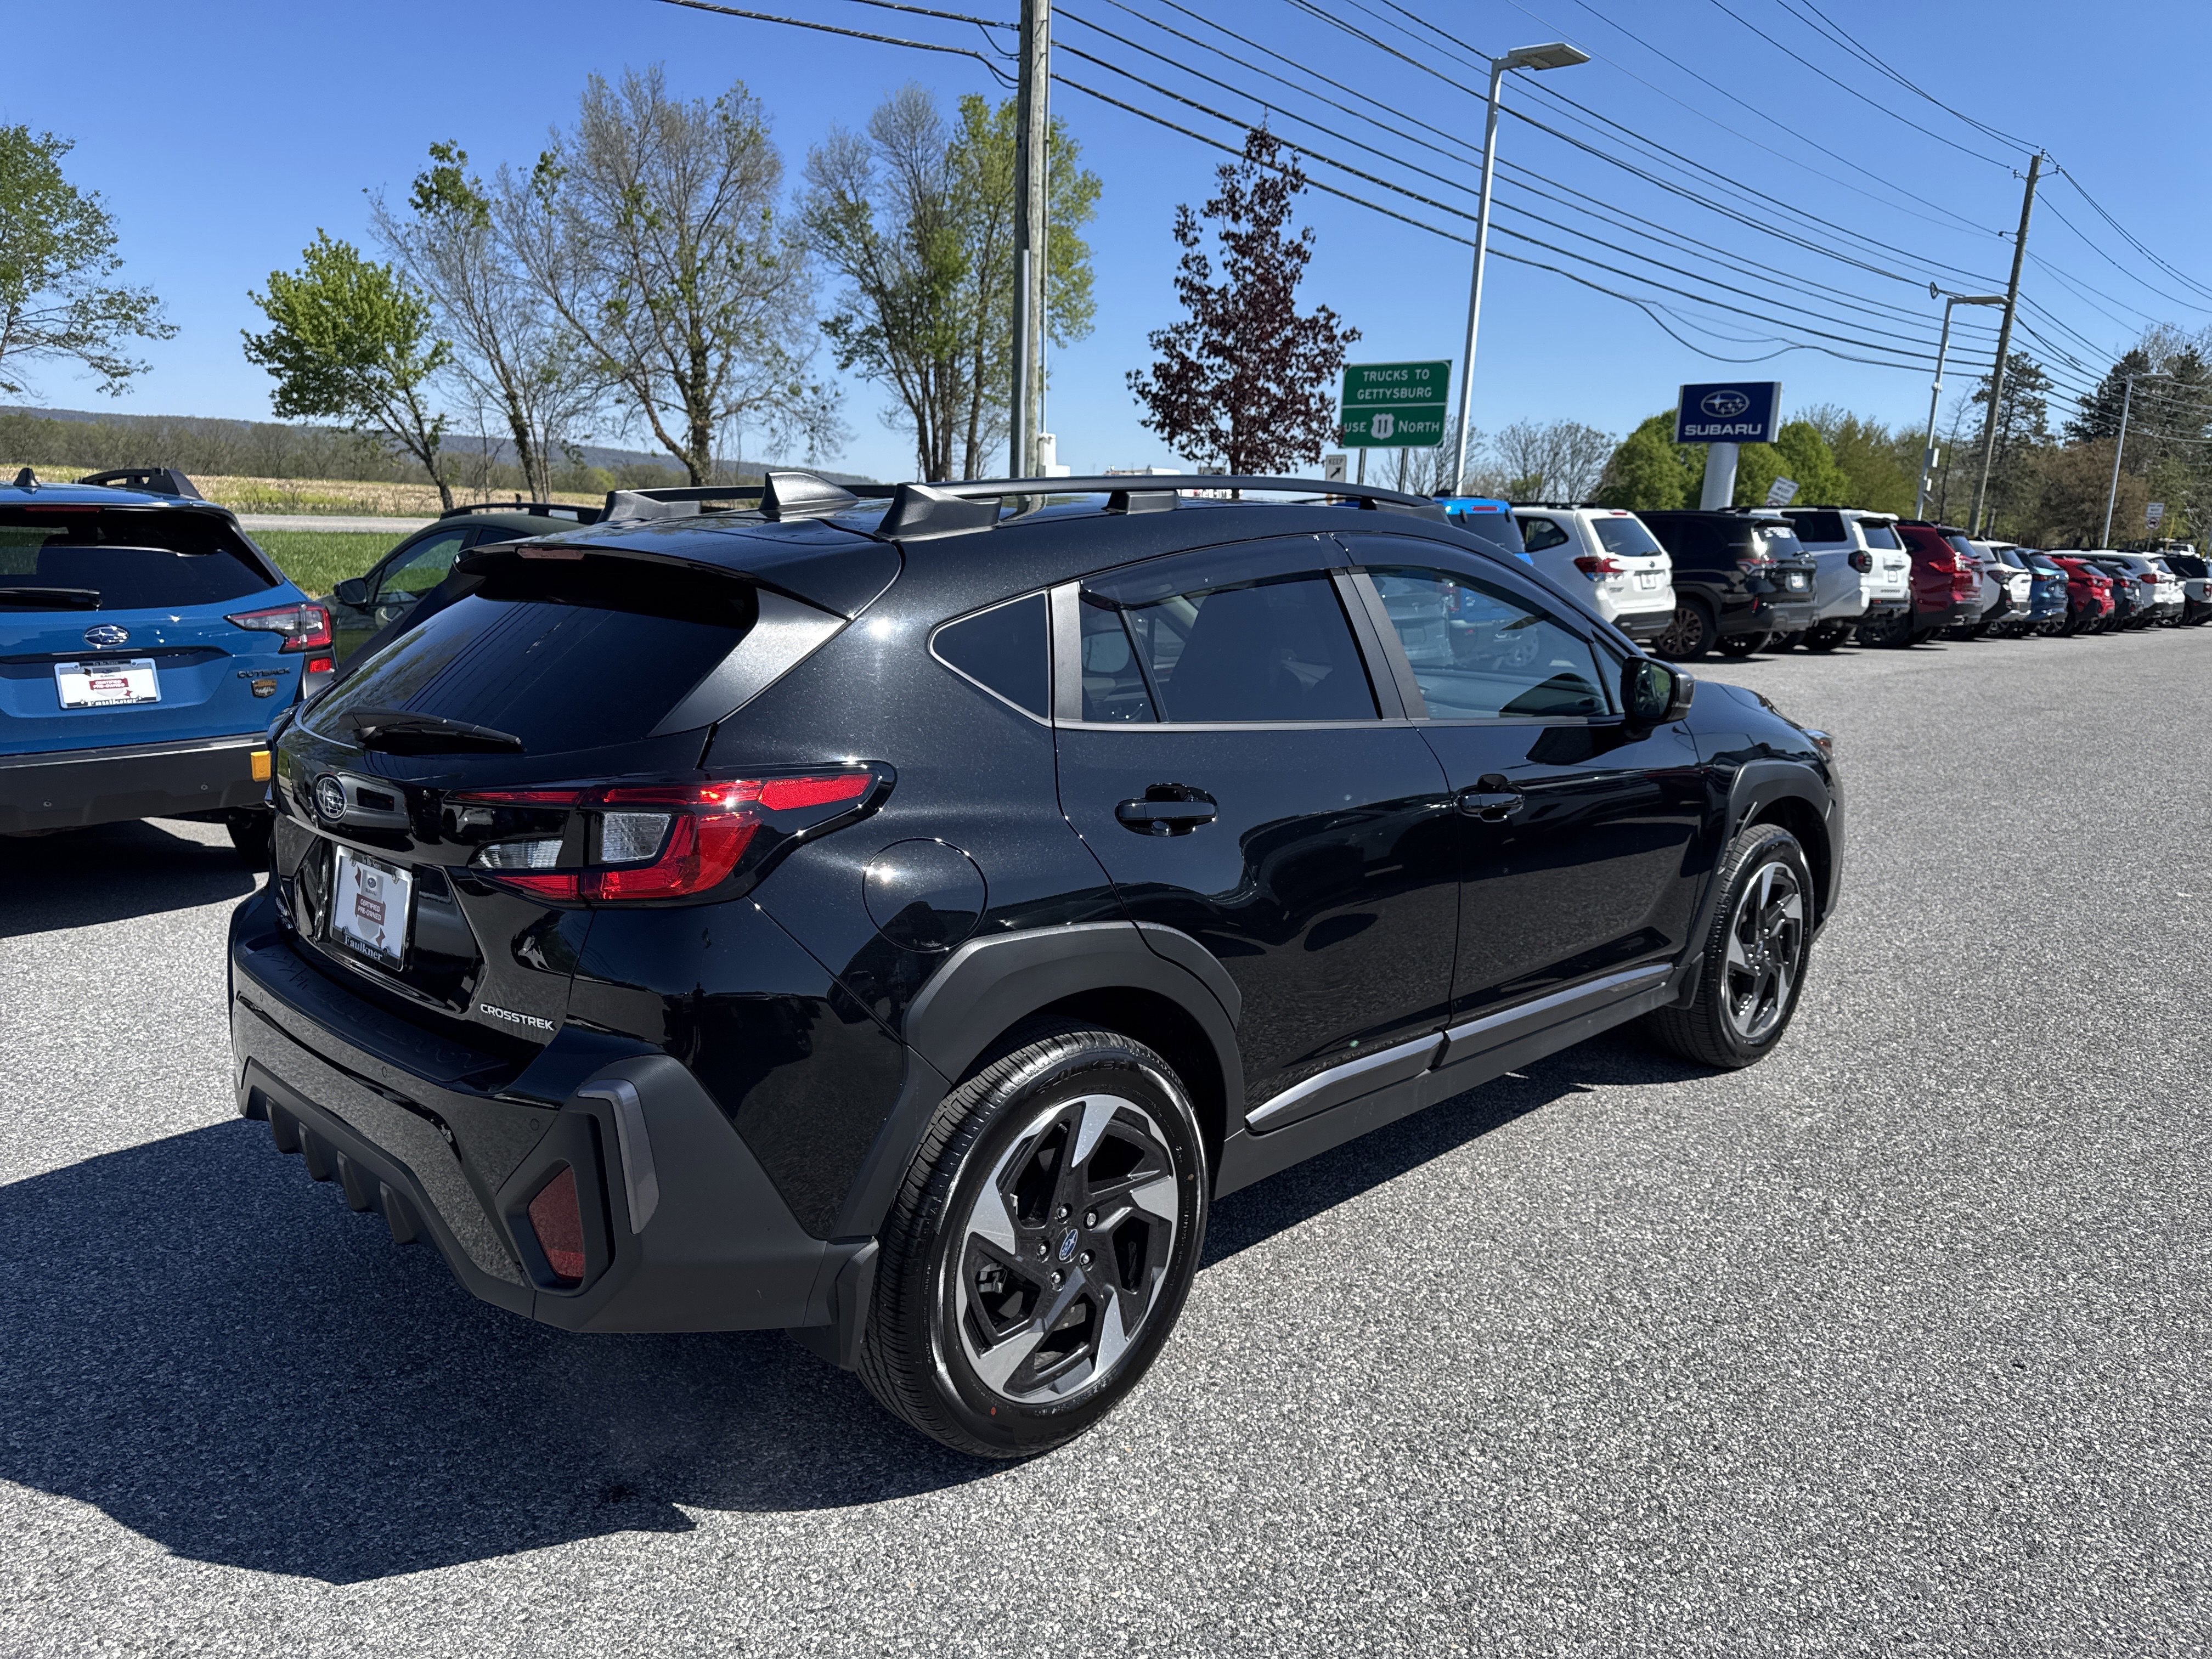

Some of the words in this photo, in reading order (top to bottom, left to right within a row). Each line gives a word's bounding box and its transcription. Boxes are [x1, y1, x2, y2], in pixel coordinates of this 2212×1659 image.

[1363, 369, 1408, 382] TRUCKS
[1414, 369, 1430, 380] TO
[1357, 387, 1432, 400] GETTYSBURG
[1344, 421, 1367, 432] USE
[1378, 419, 1389, 434] 11
[1398, 420, 1440, 433] NORTH
[1684, 424, 1762, 436] SUBARU
[1329, 458, 1344, 466] KEEP
[237, 667, 290, 678] OUTBACK
[360, 898, 381, 912] CERTIFIED
[358, 905, 382, 921] PRE-OWNED
[345, 934, 383, 961] Faulkner
[480, 1003, 555, 1031] CROSSTREK
